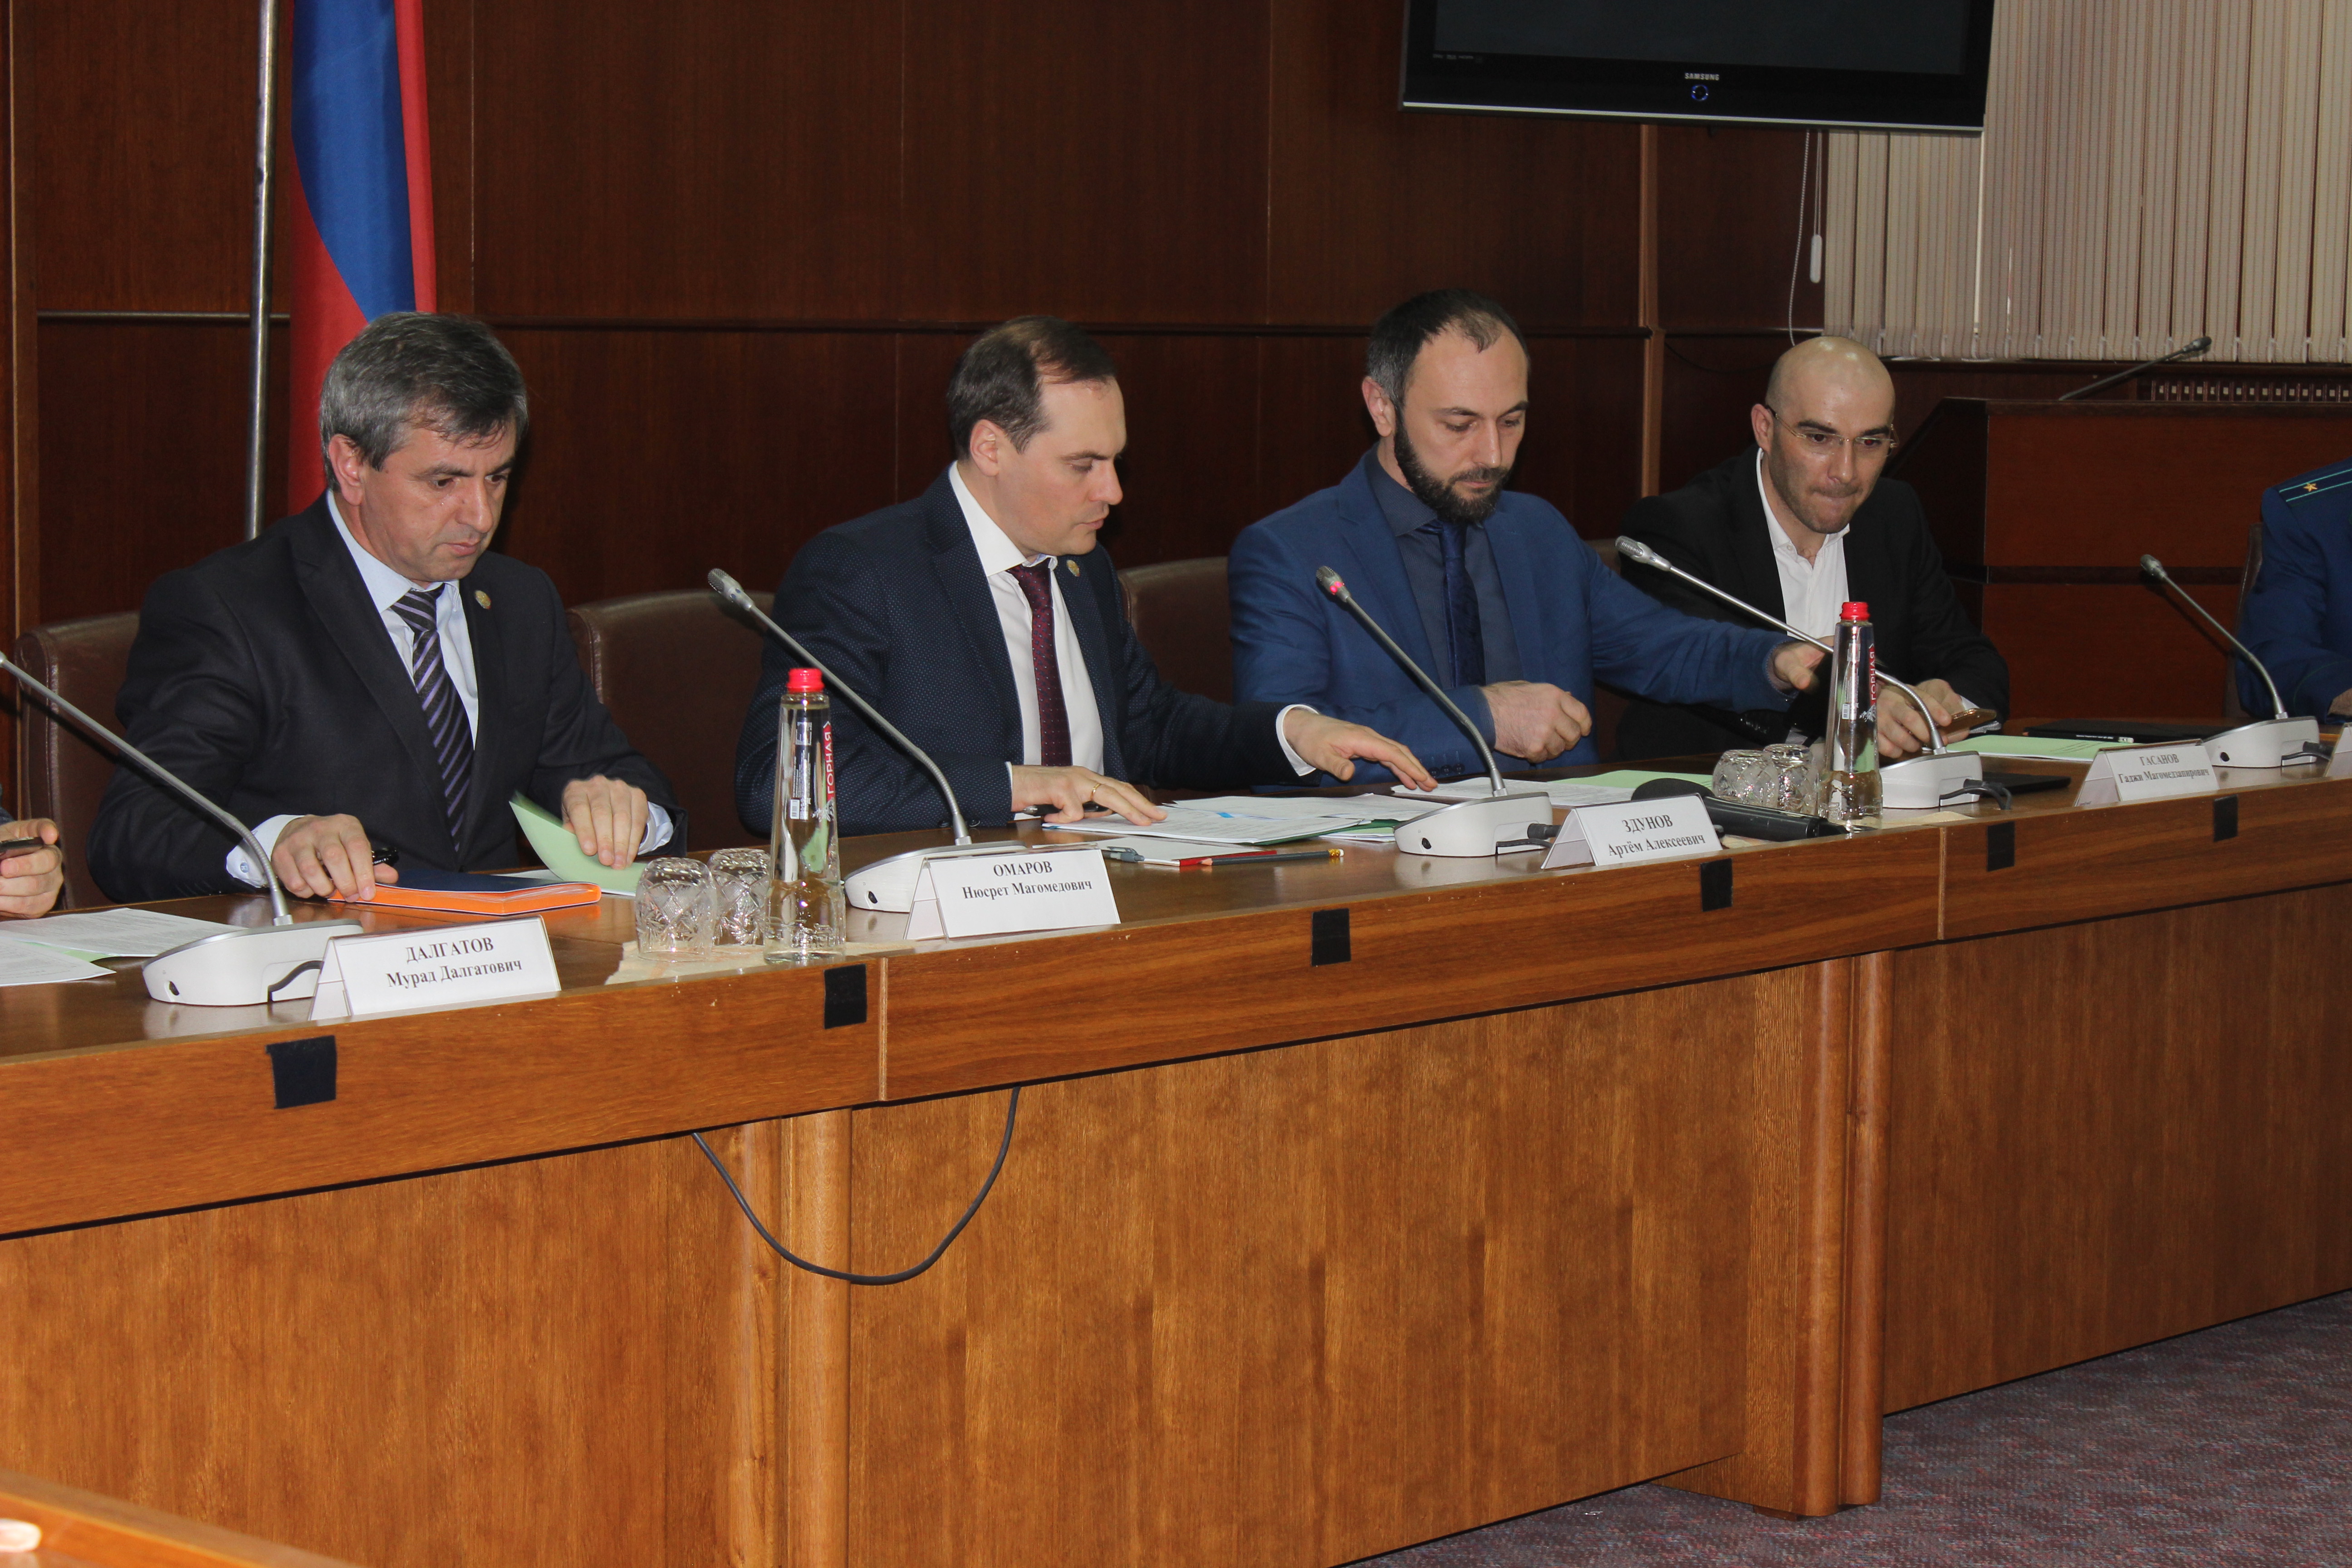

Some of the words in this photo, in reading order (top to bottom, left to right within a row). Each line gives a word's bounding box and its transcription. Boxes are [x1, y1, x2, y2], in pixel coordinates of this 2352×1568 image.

[1685, 73, 1720, 81] SAMSUNG
[825, 732, 834, 794] ГОРНАЯ
[2140, 754, 2180, 766] ГАСАНОВ
[2118, 773, 2143, 784] Гаджи
[1622, 814, 1673, 833] ЗДУНОВ
[1608, 841, 1643, 858] Артём
[1646, 835, 1706, 851] Алексеевич
[993, 861, 1053, 877] ОМАРОВ
[962, 886, 1009, 901] Нюсрет
[1011, 880, 1093, 896] Магомедович
[406, 937, 494, 964] ДАЛГАТОВ
[386, 970, 436, 989] Мурад
[441, 960, 523, 982] Далгатович
